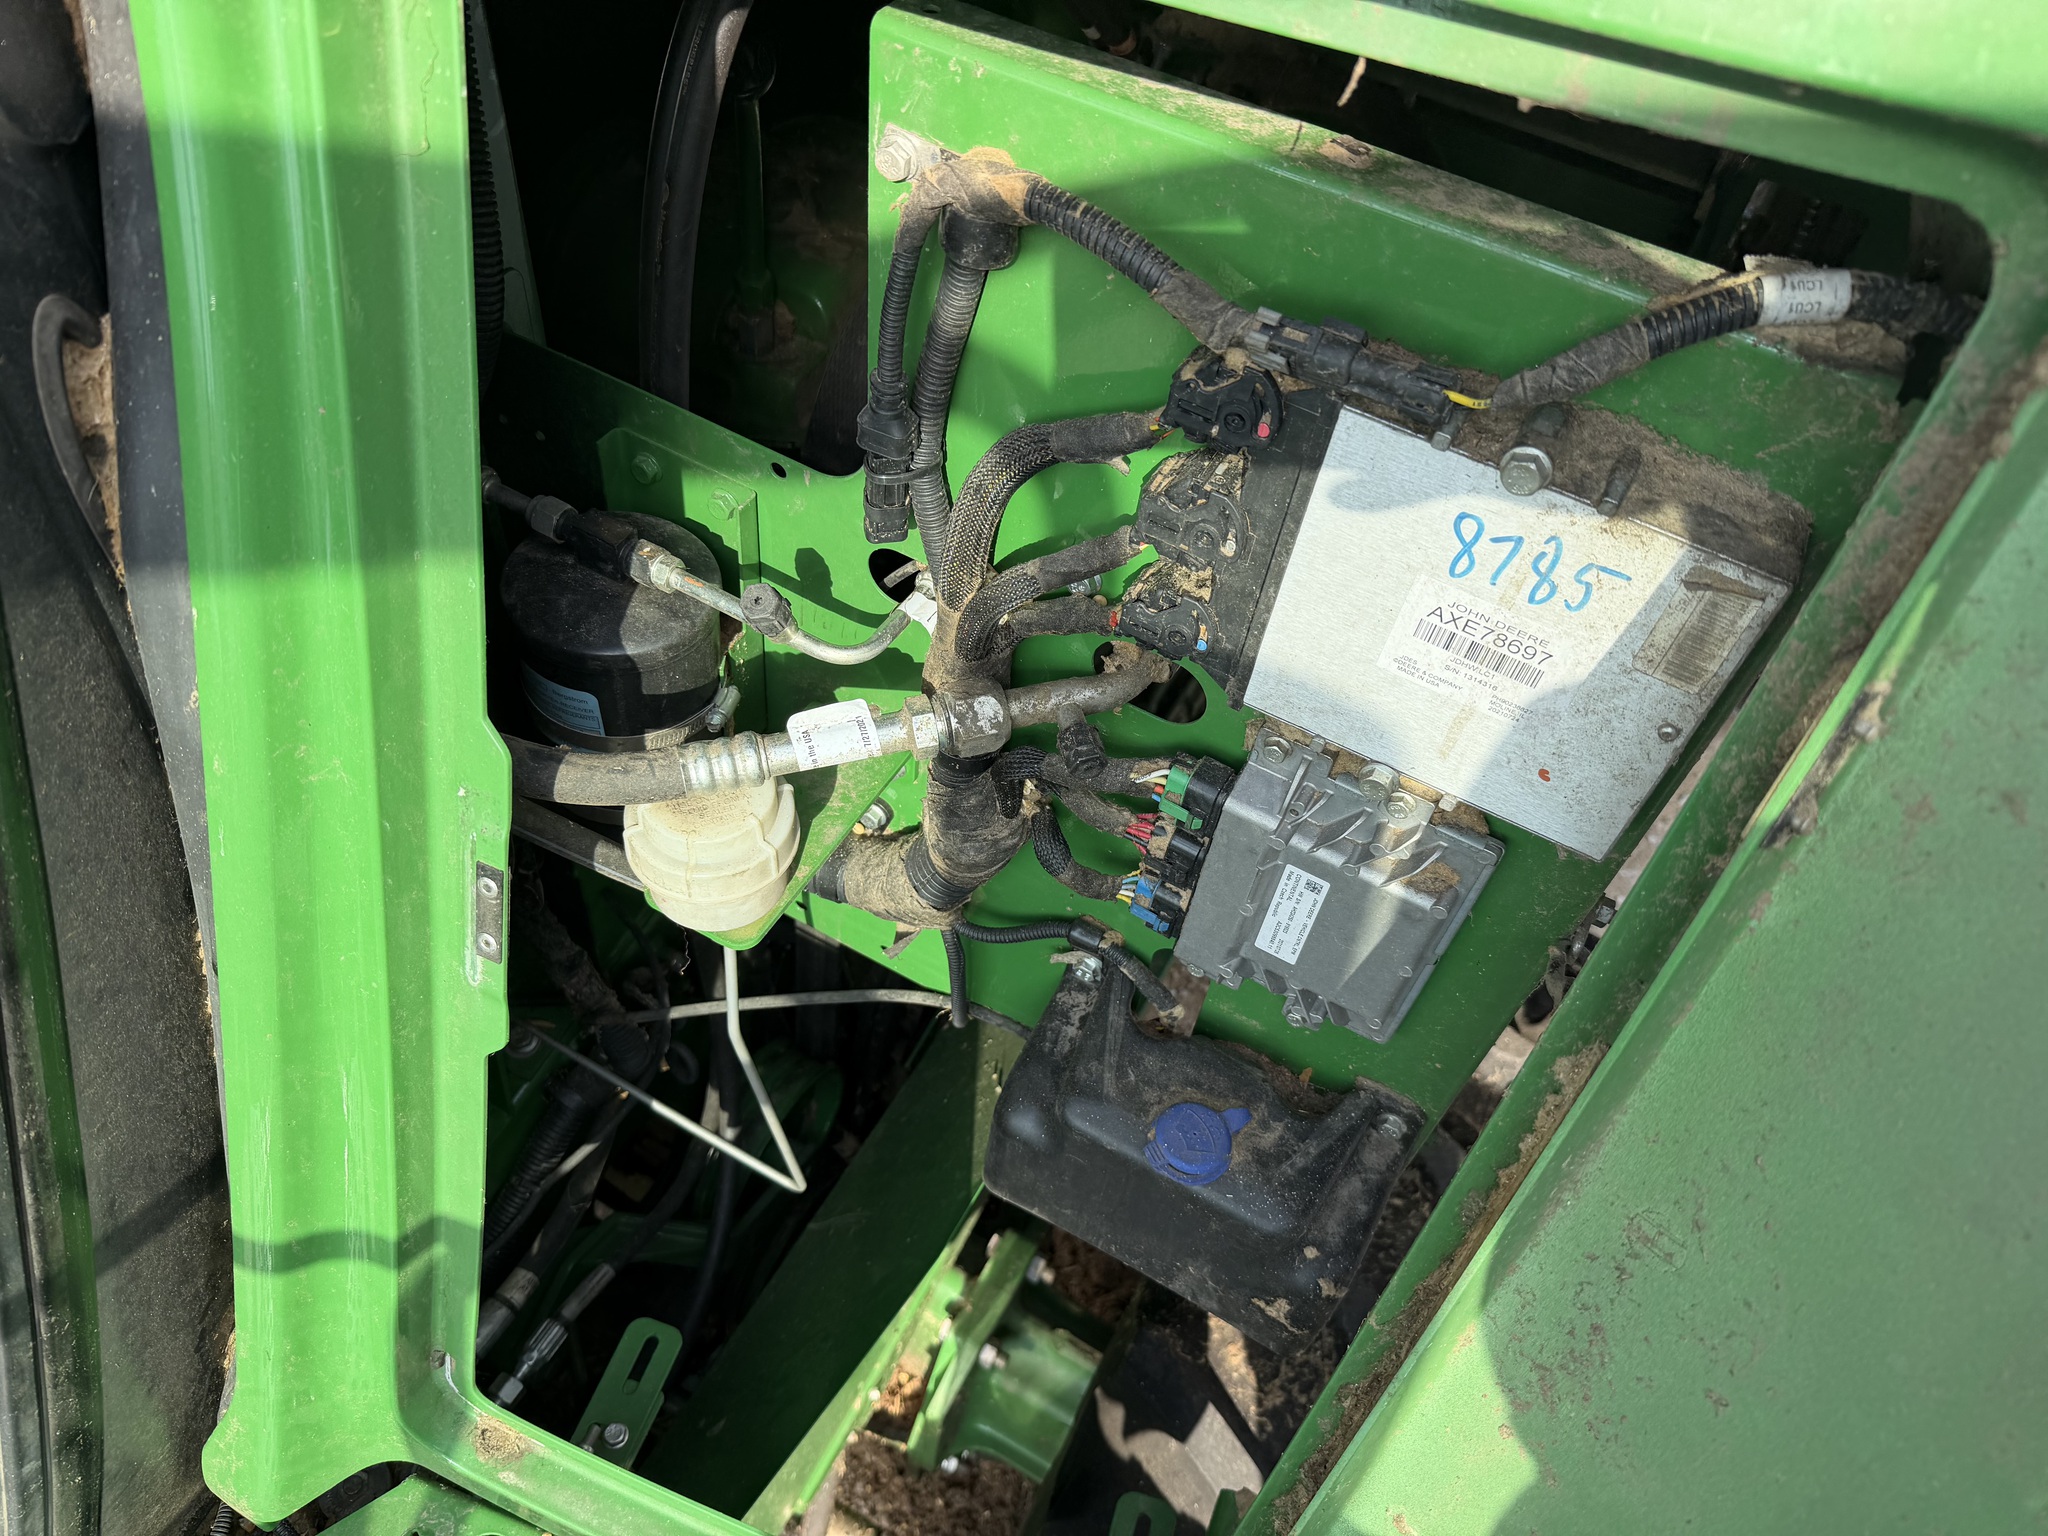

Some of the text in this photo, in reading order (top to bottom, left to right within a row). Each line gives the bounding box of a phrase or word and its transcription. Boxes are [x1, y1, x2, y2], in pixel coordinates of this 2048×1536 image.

[1790, 279, 1824, 291] LCU1
[1788, 301, 1823, 314] LCU1
[1448, 511, 1633, 613] 8785
[1447, 601, 1551, 649] JOHN DEERE
[1426, 606, 1554, 666] AXE78697
[1399, 654, 1418, 666] JDES
[1396, 665, 1441, 689] MADE IN USA
[1427, 671, 1464, 691] COMPANY
[1443, 664, 1499, 692] S/N: 1314316
[801, 729, 813, 744] USA
[855, 715, 873, 748] 7/27/2021
[1285, 869, 1295, 883] Made
[1279, 887, 1288, 900] Czech
[1285, 872, 1303, 903] CONTINENTAL
[1271, 900, 1283, 918] Republic
